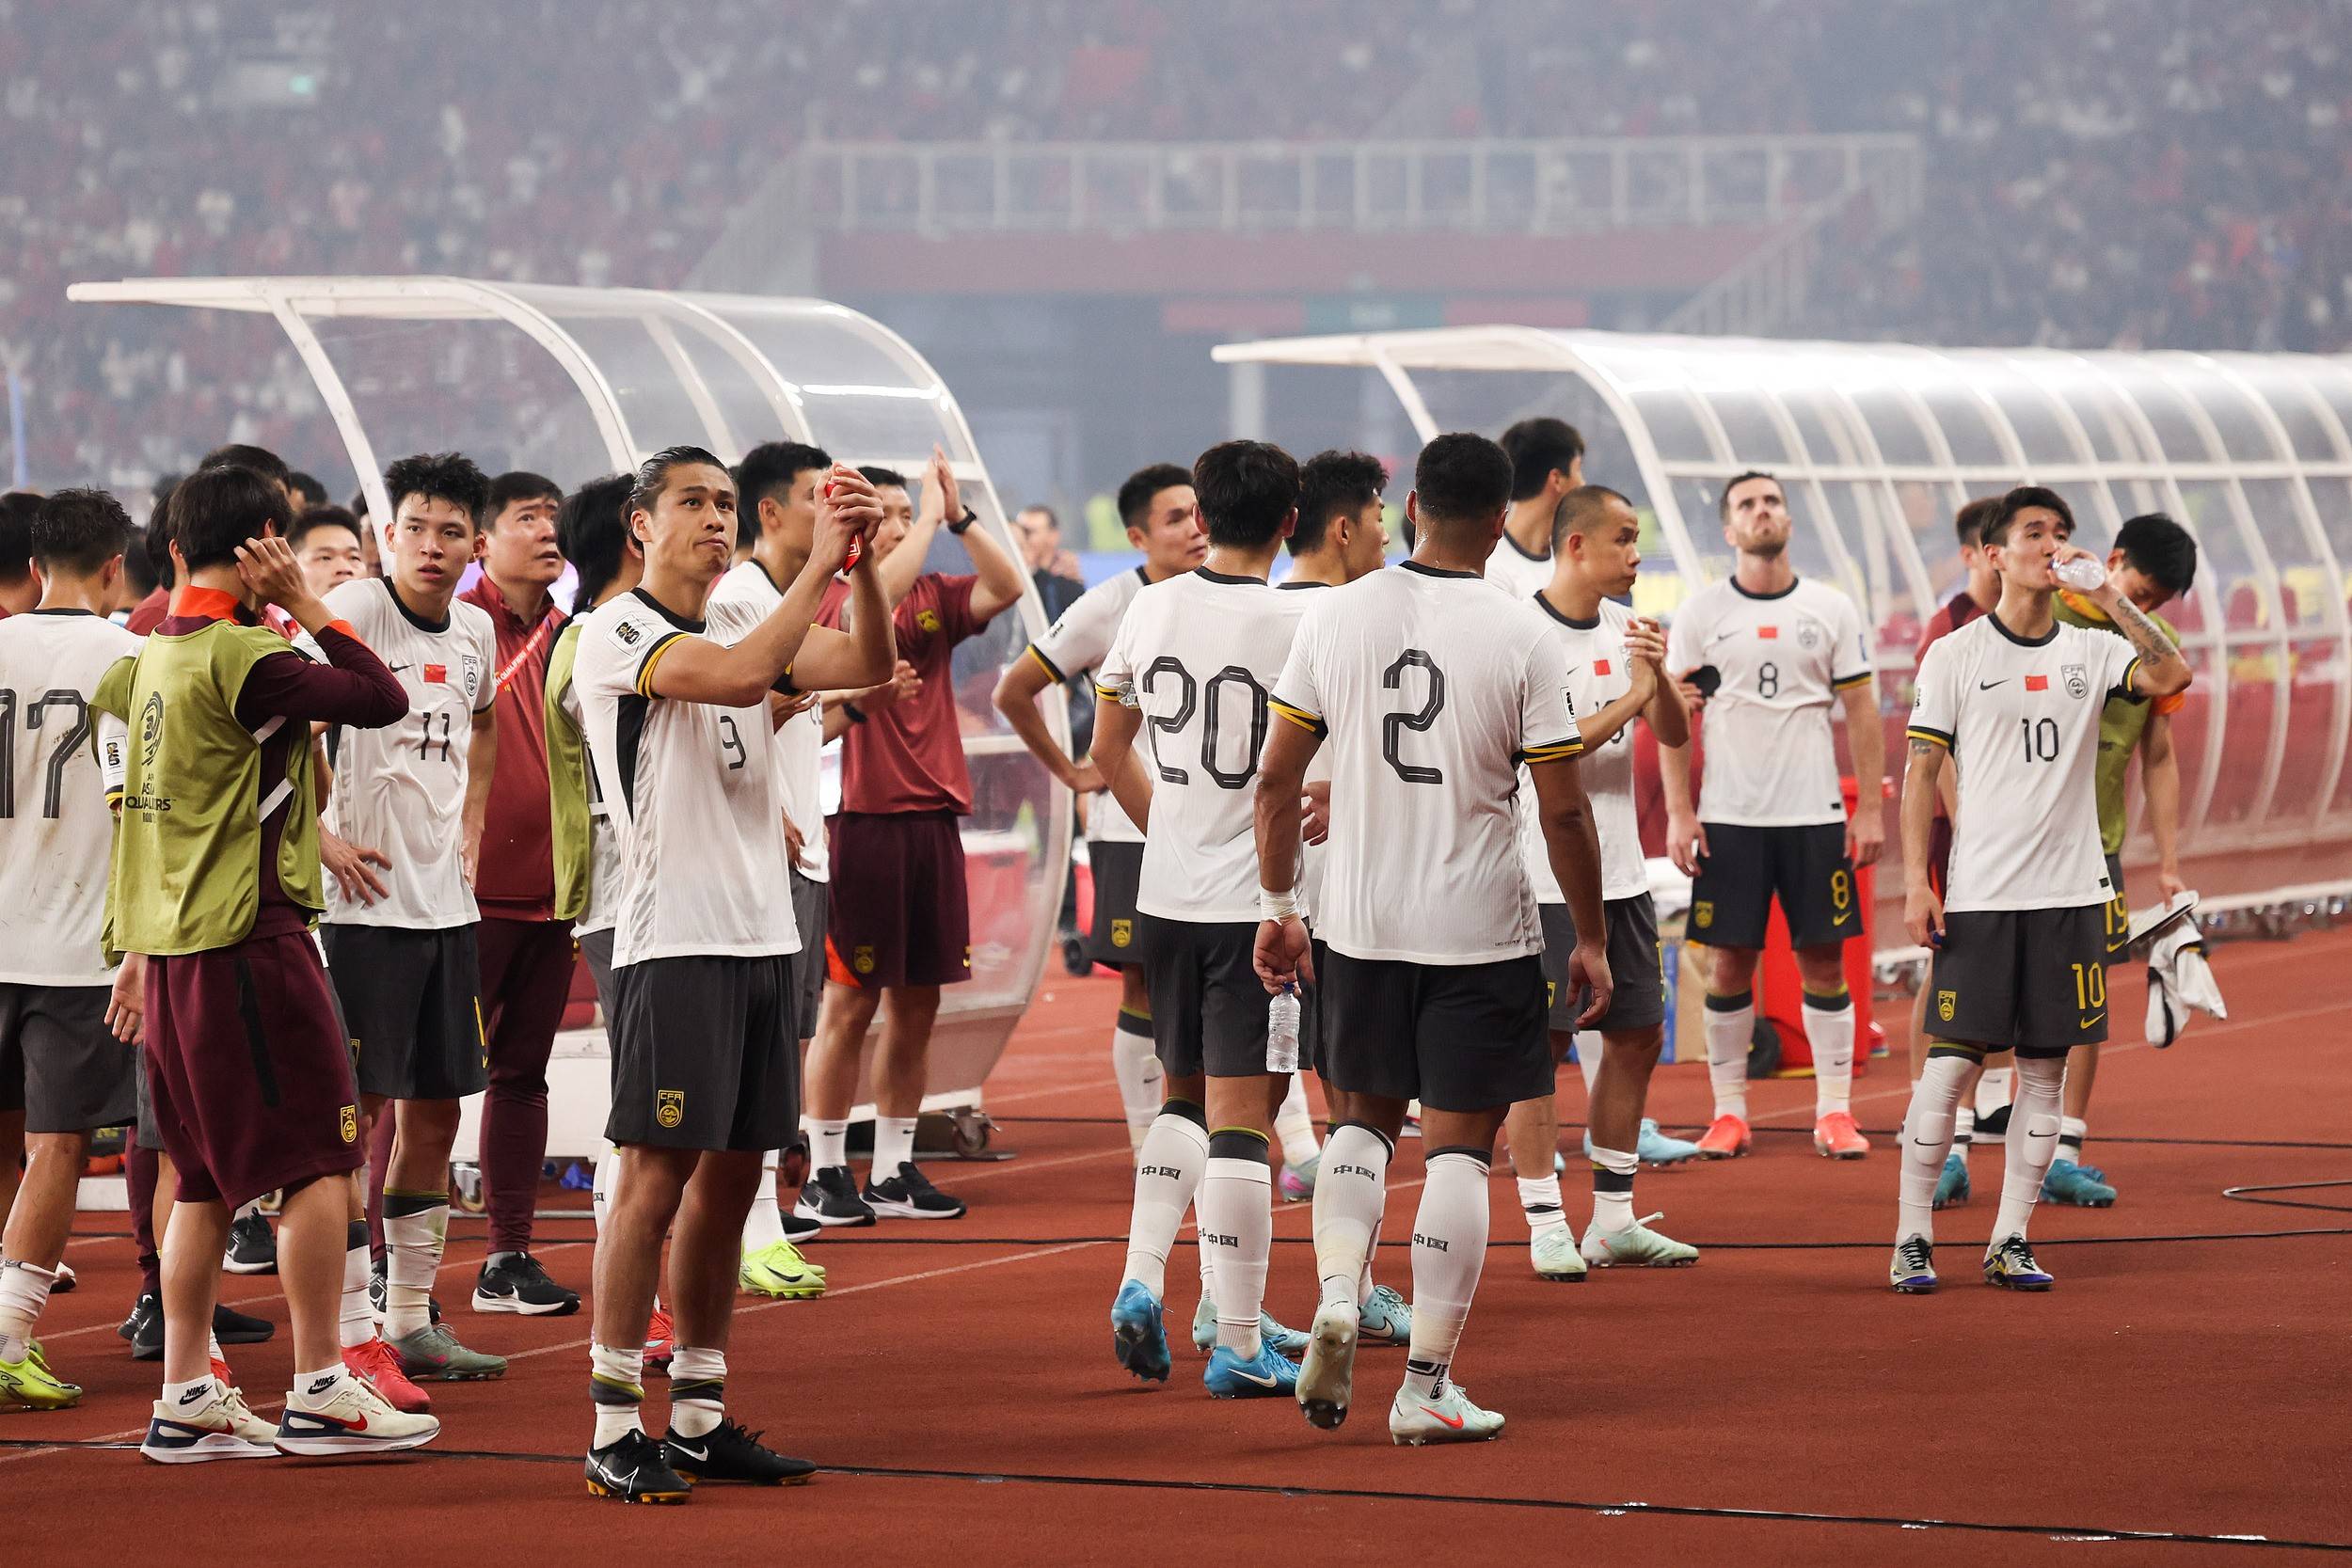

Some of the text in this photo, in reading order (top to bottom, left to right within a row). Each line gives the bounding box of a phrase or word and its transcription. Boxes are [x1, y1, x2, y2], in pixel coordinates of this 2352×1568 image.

[1758, 661, 1778, 699] 8
[1142, 656, 1270, 790] 20
[1383, 648, 1445, 784] 2
[420, 711, 451, 763] 11
[2022, 718, 2059, 763] 10
[1831, 870, 1850, 910] 8
[2106, 891, 2129, 935] 19
[2072, 962, 2106, 1010] 10
[660, 1092, 682, 1101] CFA
[1141, 1165, 1182, 1180] 中国
[1333, 1164, 1376, 1181] 中国
[1207, 1233, 1239, 1248] 中国
[1413, 1232, 1450, 1253] 中国
